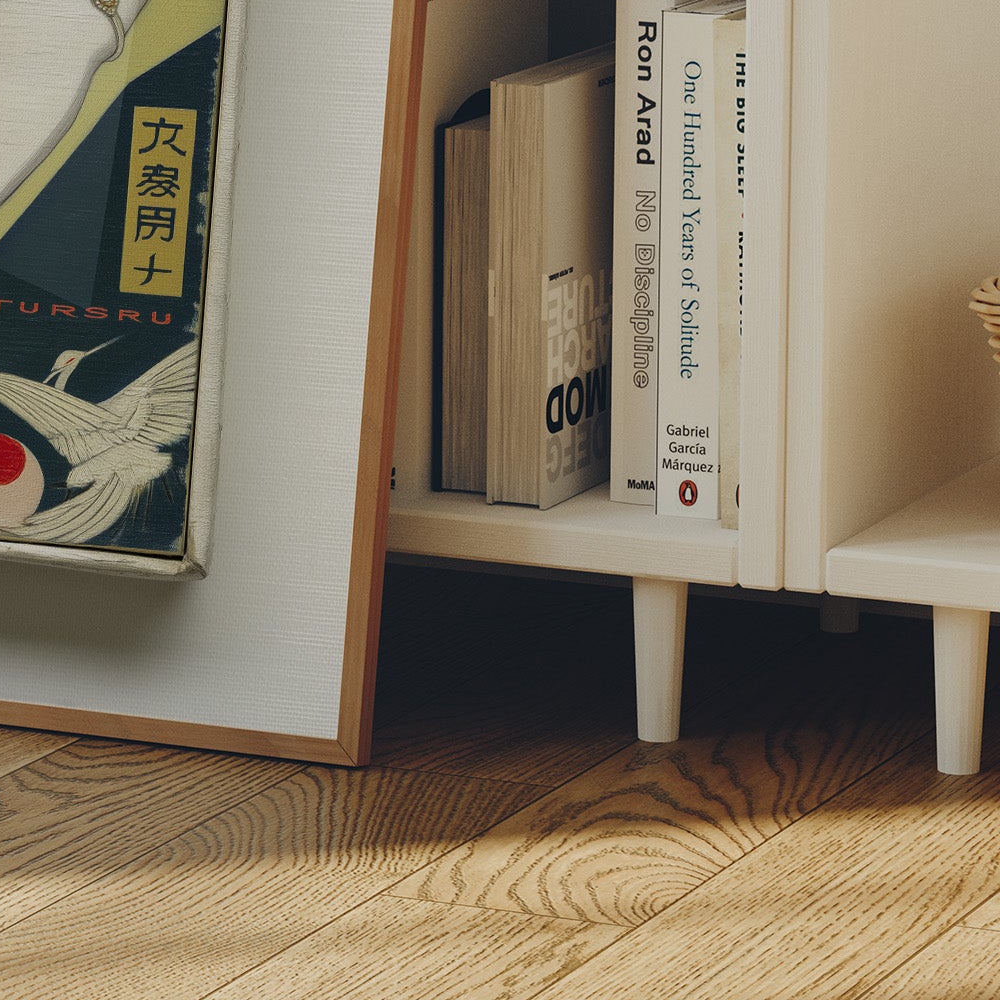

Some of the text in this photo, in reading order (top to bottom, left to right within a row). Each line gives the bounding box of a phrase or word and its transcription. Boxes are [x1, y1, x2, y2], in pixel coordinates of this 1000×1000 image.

[630, 20, 657, 389] Ron Arad No Discipline
[680, 61, 702, 379] One Hundred Years of Solitude
[666, 424, 709, 438] Gabriel
[668, 441, 706, 455] García
[662, 458, 714, 474] Márquez
[627, 479, 655, 490] MoMA
